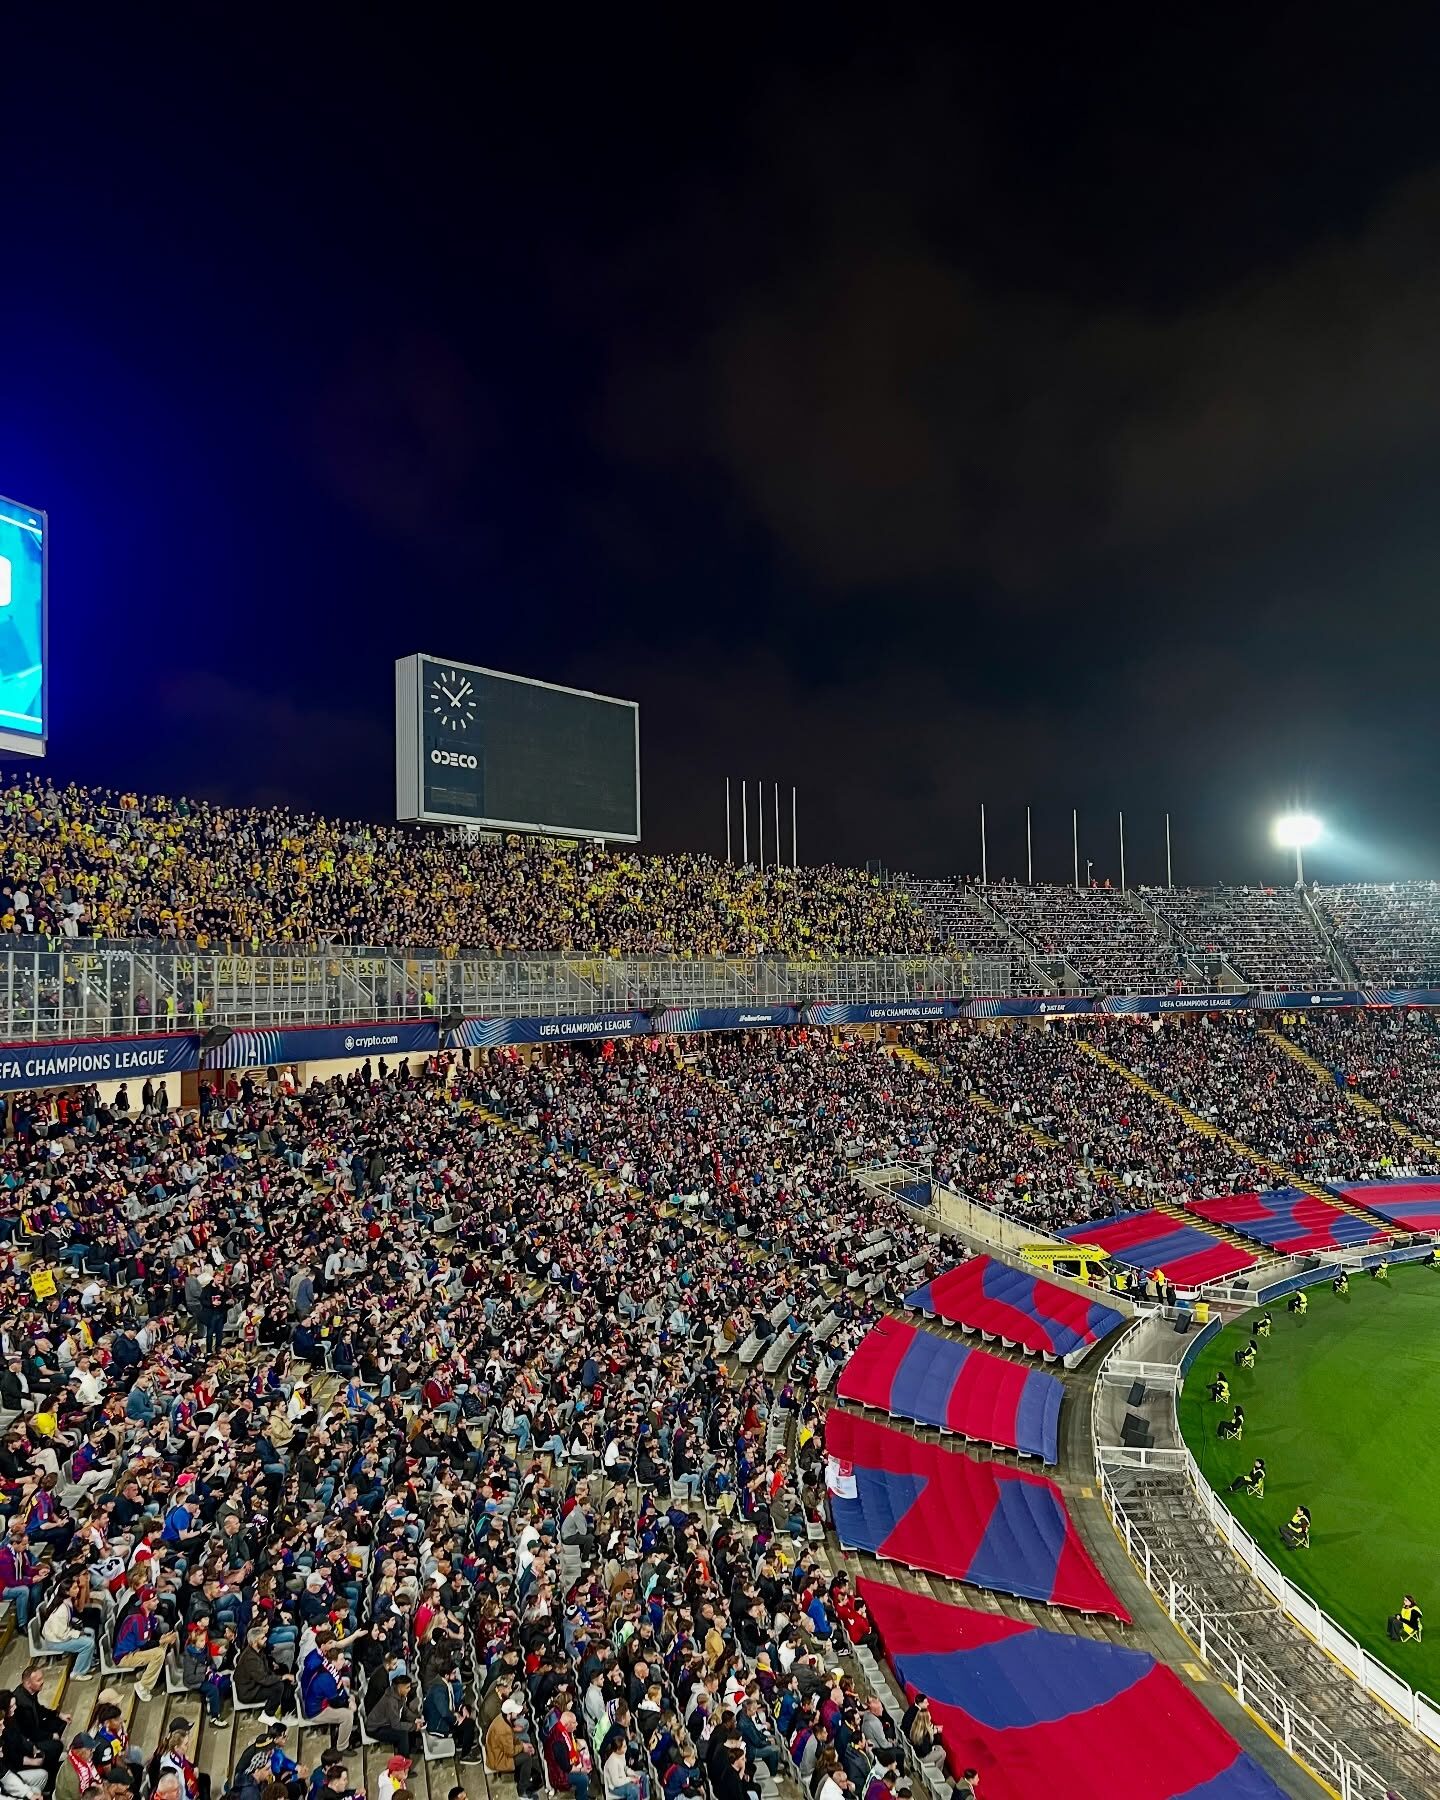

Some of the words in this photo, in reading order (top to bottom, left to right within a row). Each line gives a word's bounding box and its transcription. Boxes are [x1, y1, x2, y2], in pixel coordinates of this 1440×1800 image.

[431, 750, 478, 769] ODECO
[1160, 1000, 1175, 1008] UEFA
[1175, 999, 1209, 1008] CHAMPIONS
[870, 1009, 886, 1018] UEFA
[886, 1007, 921, 1017] CHAMPIONS
[921, 1006, 944, 1015] LEAGUE
[539, 1024, 560, 1036] UEFA
[561, 1021, 603, 1035] CHAMPIONS
[604, 1019, 632, 1031] LEAGUE
[355, 1035, 398, 1048] crypto.com
[25, 1053, 111, 1078] CHAMPIONS
[115, 1049, 165, 1069] LEAGUE
